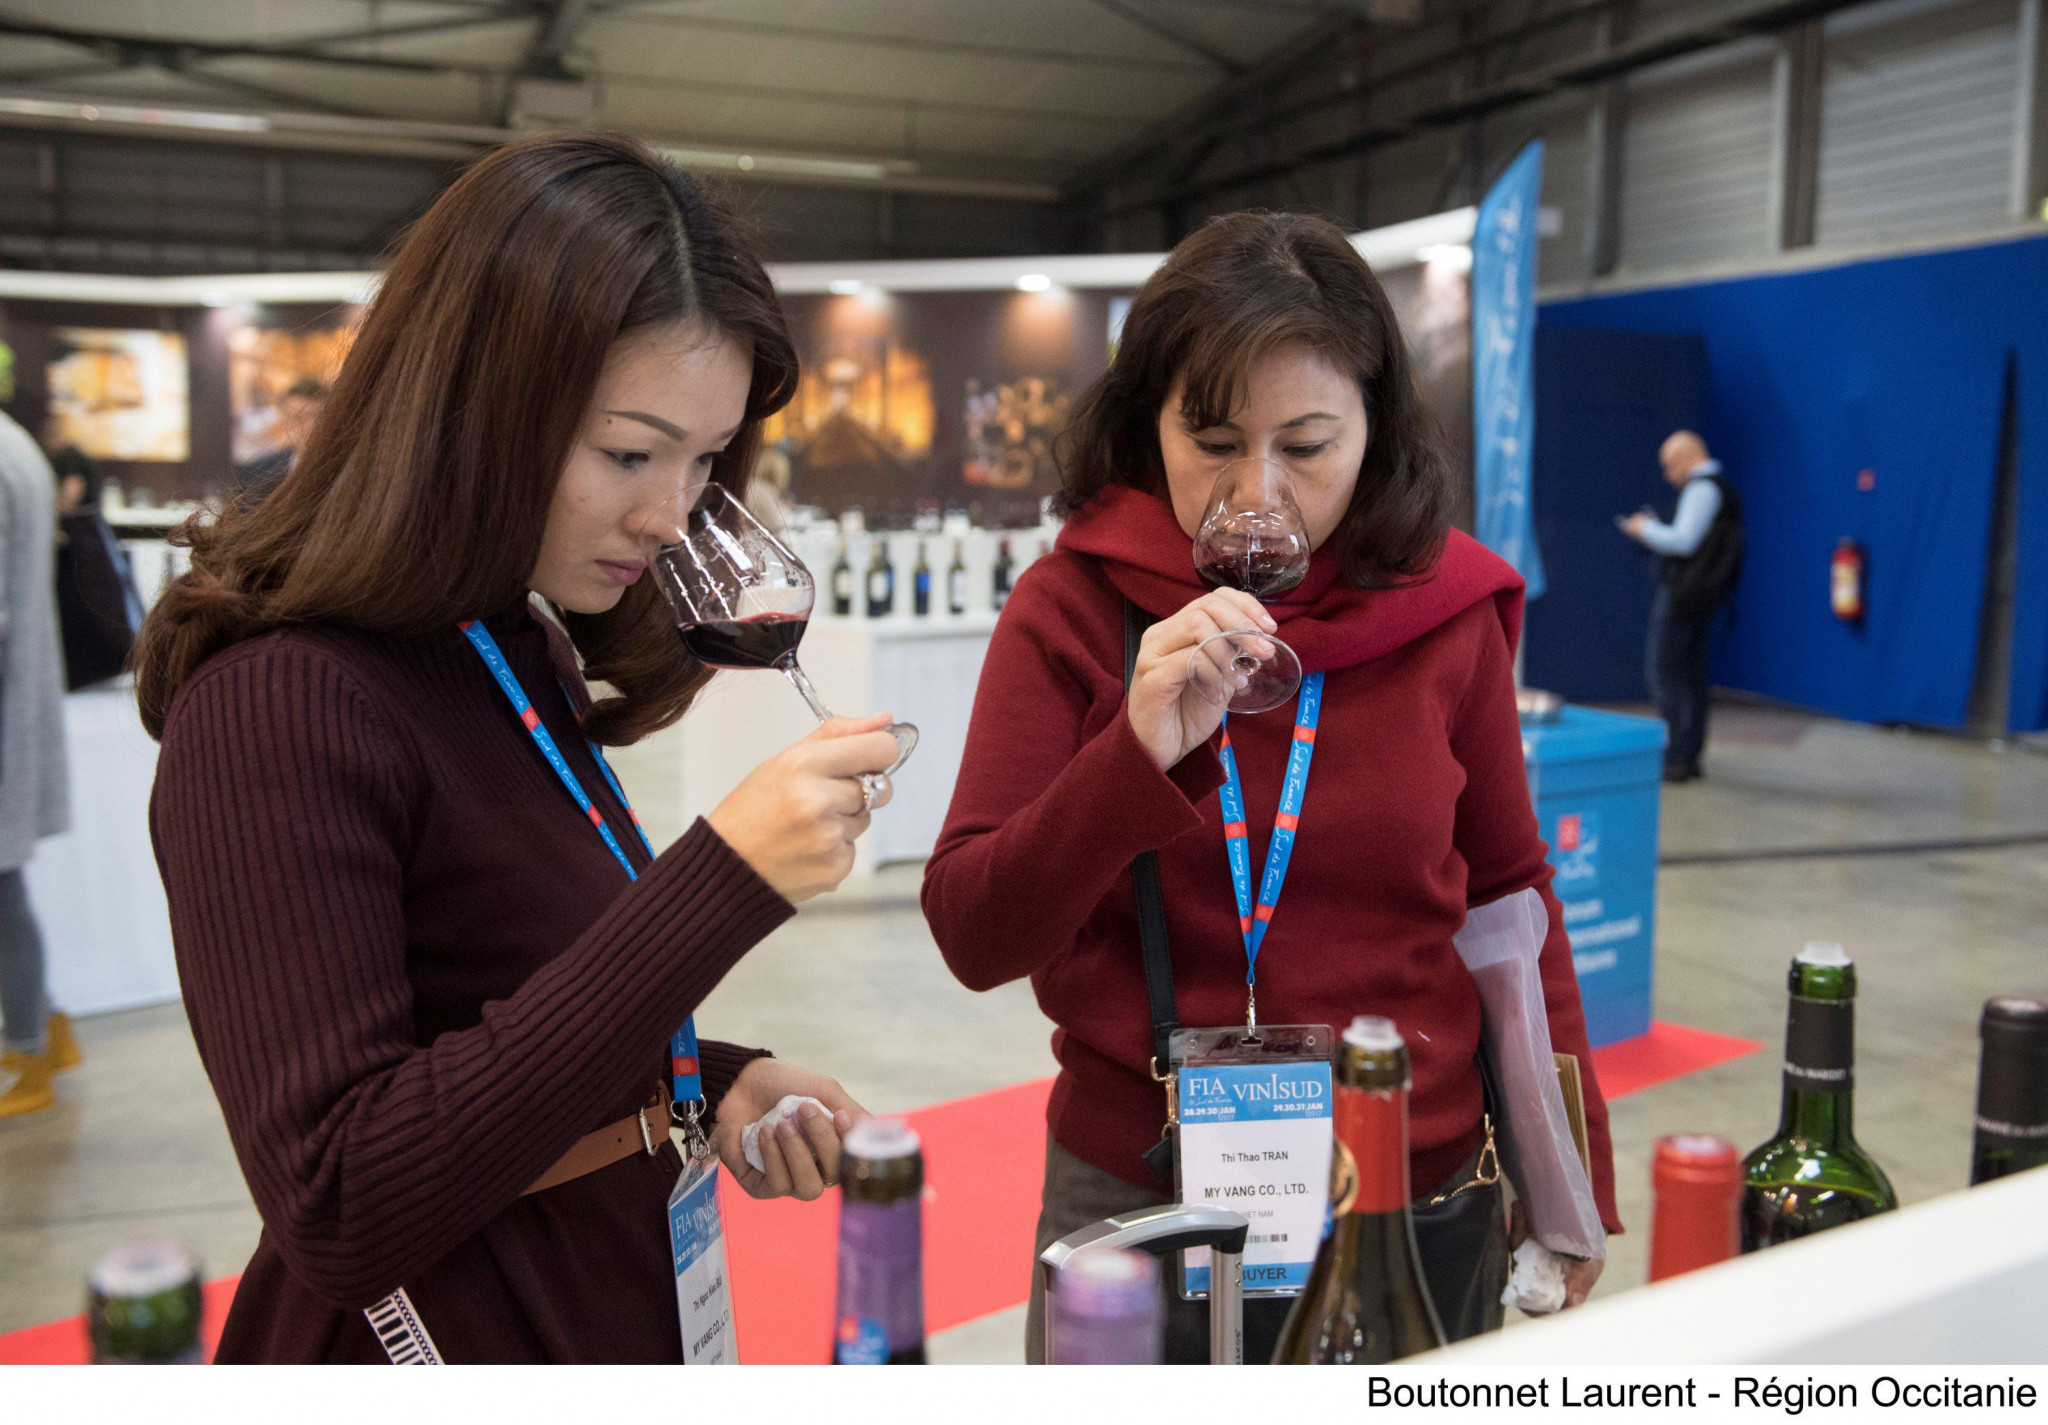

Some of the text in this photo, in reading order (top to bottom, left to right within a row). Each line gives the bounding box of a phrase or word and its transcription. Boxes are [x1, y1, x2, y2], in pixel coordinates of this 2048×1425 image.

[498, 667, 524, 710] France
[1284, 739, 1309, 812] Sud de France
[1263, 827, 1290, 902] Sud de France
[1189, 1074, 1323, 1100] FIA VINISUD
[1307, 1102, 1323, 1110] JAN
[1221, 1151, 1288, 1163] Thi Thao TRAN
[1205, 1183, 1309, 1198] MY VANG CO., LTD.
[1258, 1210, 1274, 1218] NAM
